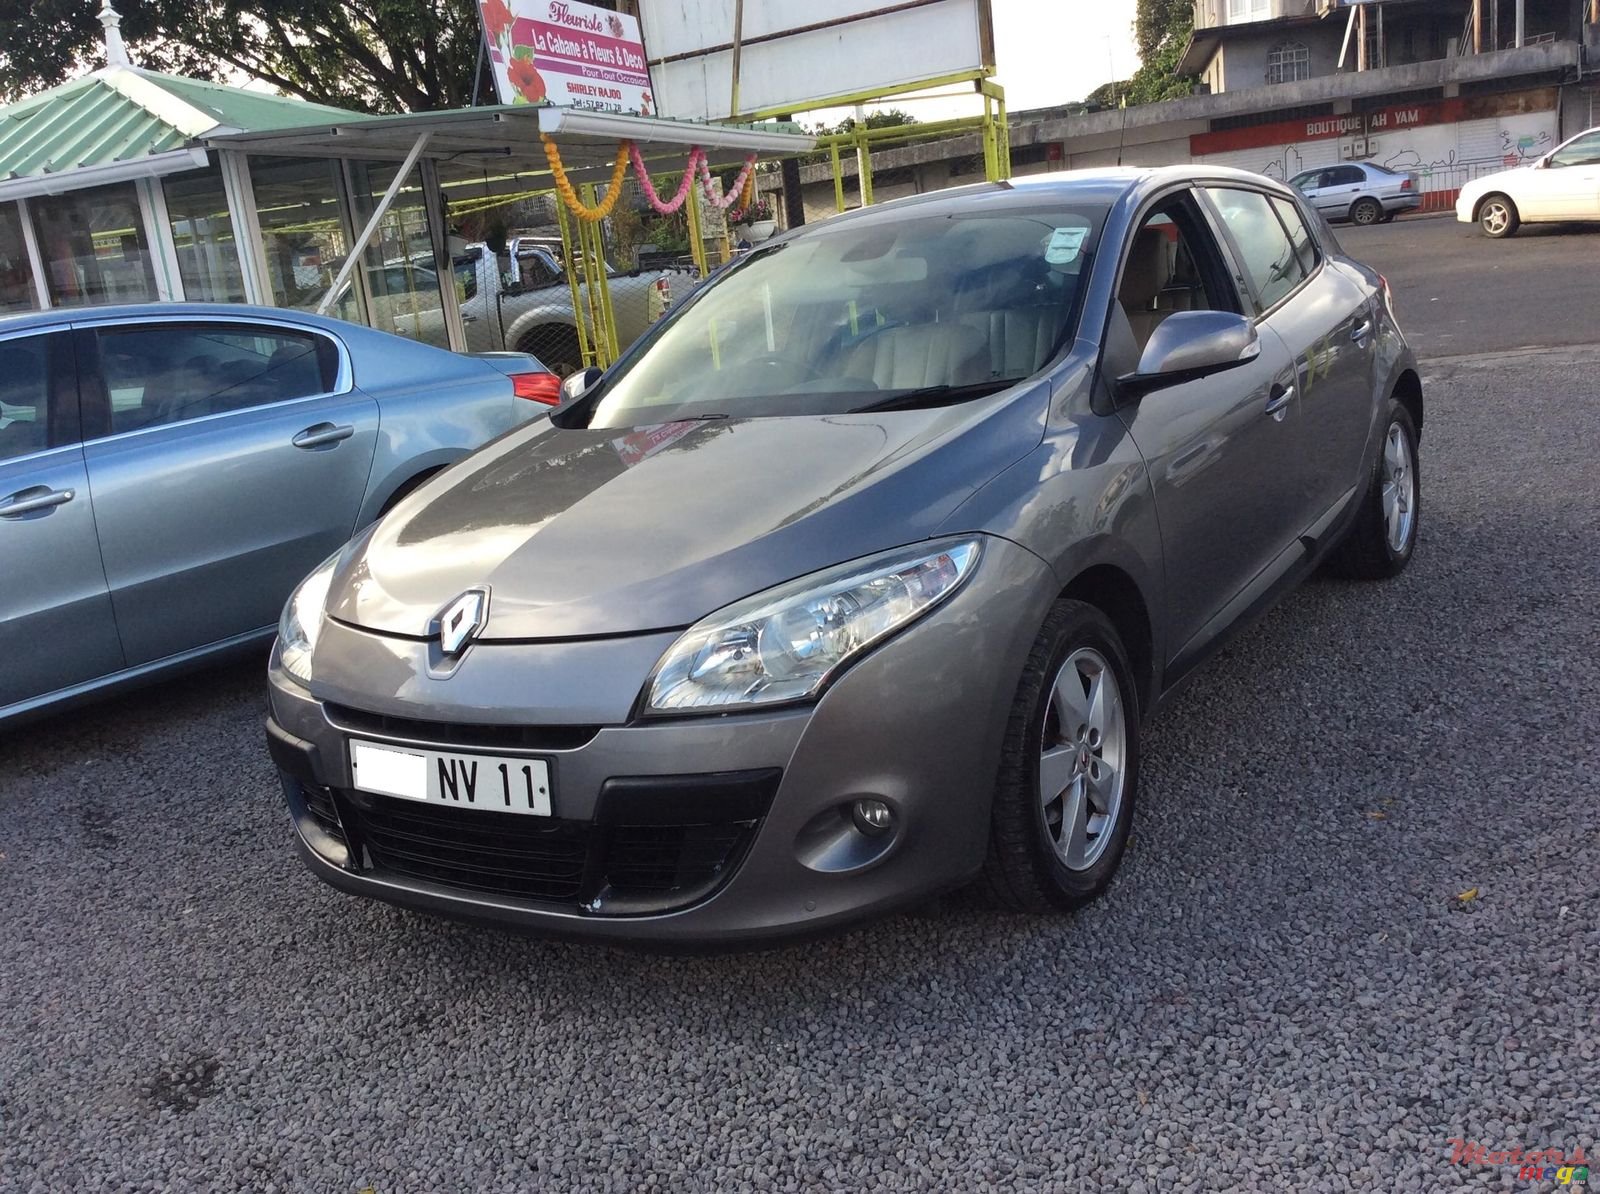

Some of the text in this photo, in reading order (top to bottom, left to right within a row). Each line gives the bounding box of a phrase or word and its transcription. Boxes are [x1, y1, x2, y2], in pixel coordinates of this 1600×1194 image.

[532, 28, 643, 70] La Cabane à Fleurs & Deco
[566, 82, 597, 97] SHIRLEY
[581, 66, 648, 86] Pour Tout Occasion
[1307, 109, 1419, 136] BOUTIQUE AH YAM
[438, 758, 534, 808] NV 11
